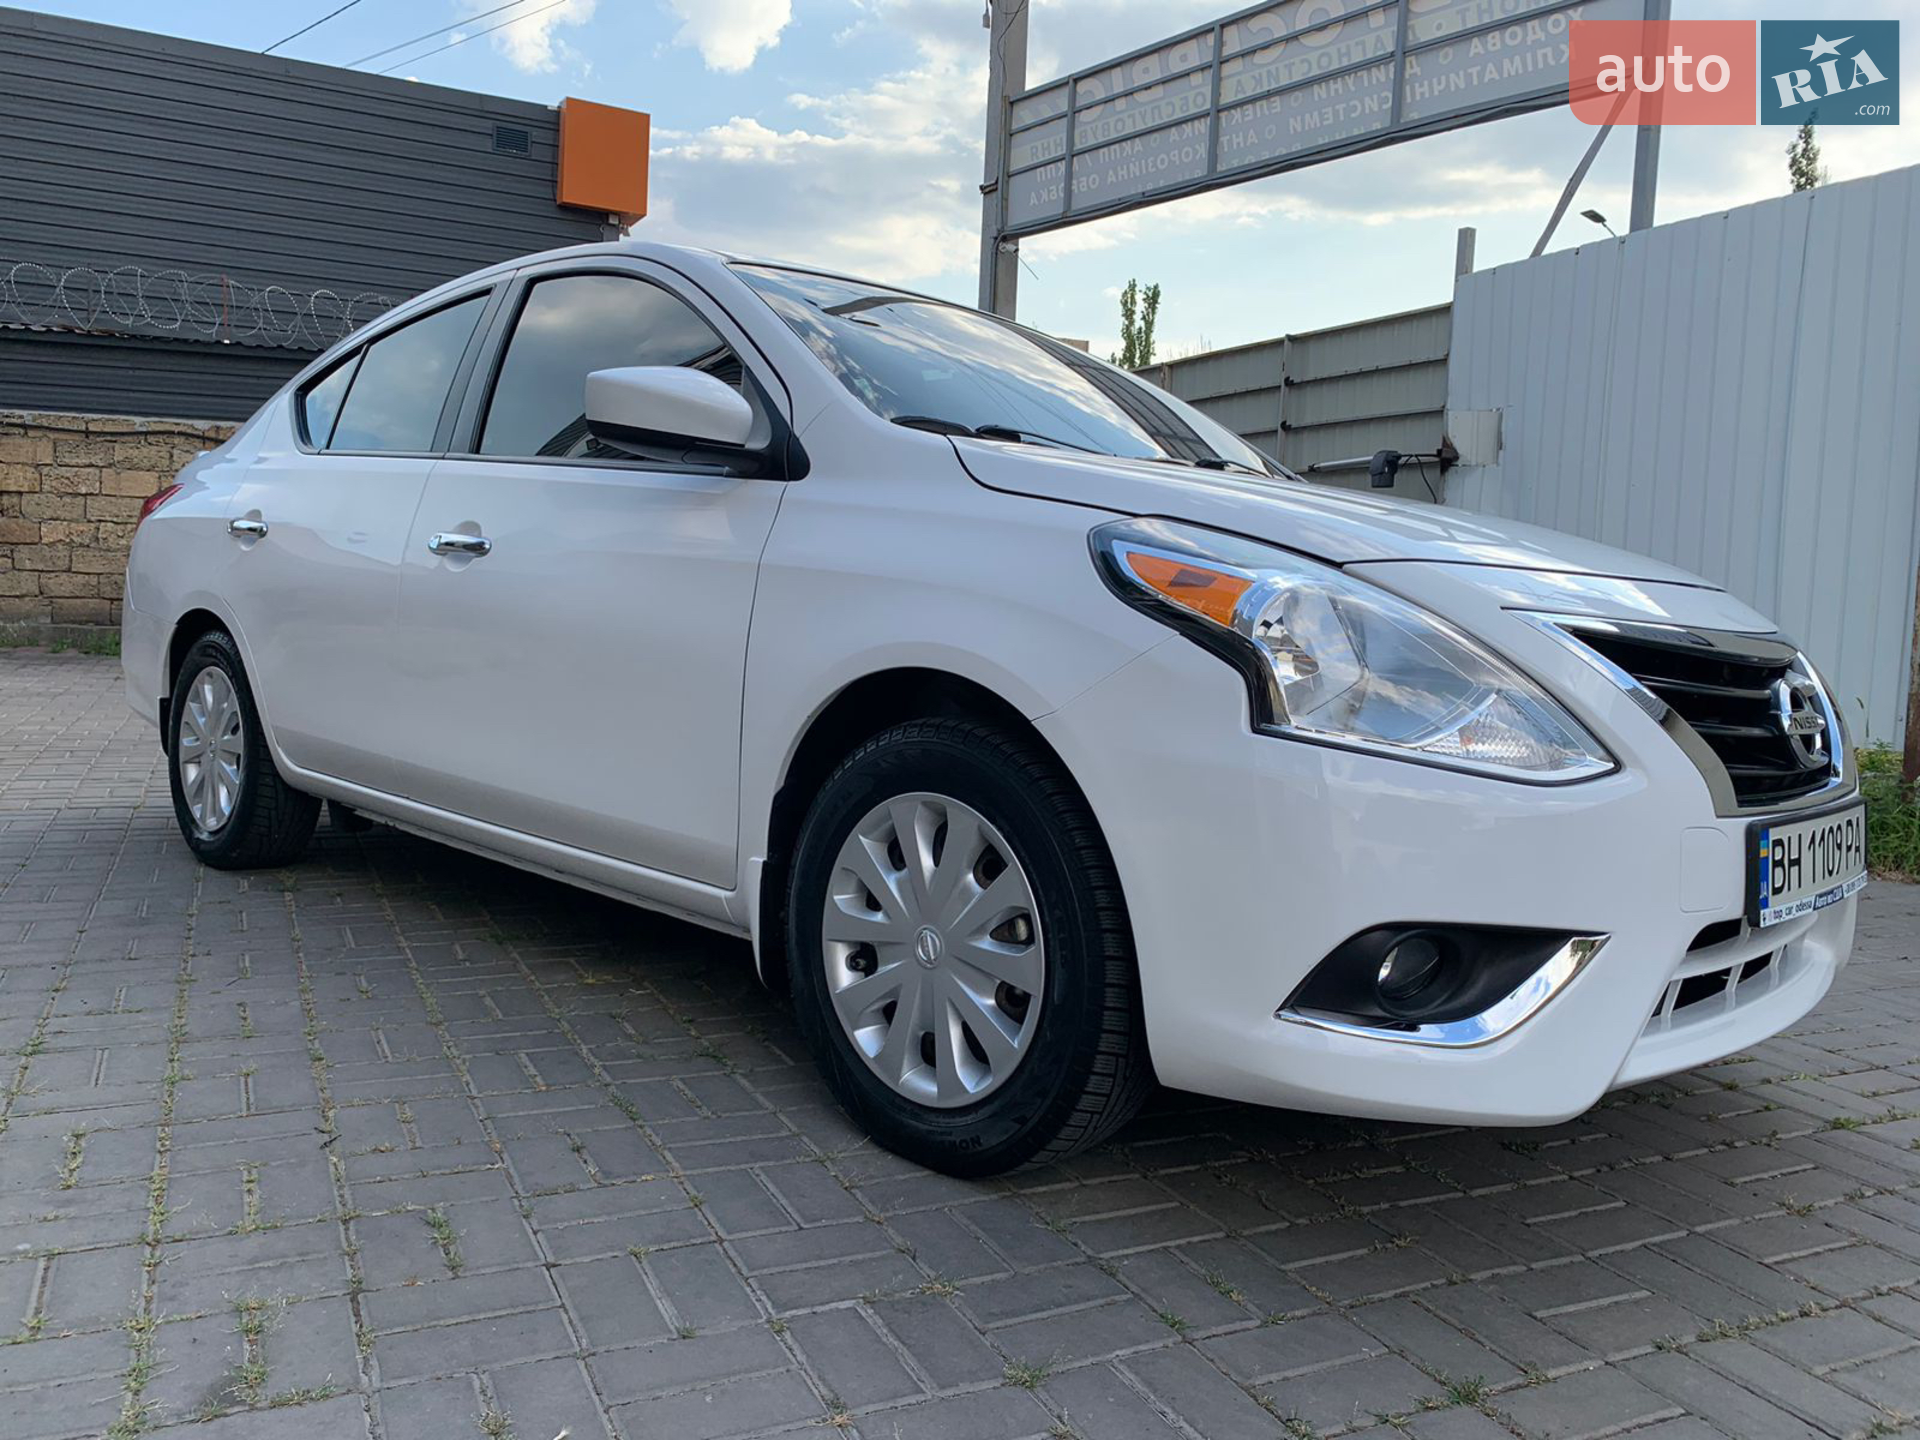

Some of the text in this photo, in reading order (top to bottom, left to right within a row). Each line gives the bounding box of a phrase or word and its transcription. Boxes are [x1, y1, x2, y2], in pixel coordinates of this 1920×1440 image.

[1771, 816, 1862, 896] BH 1109 PA
